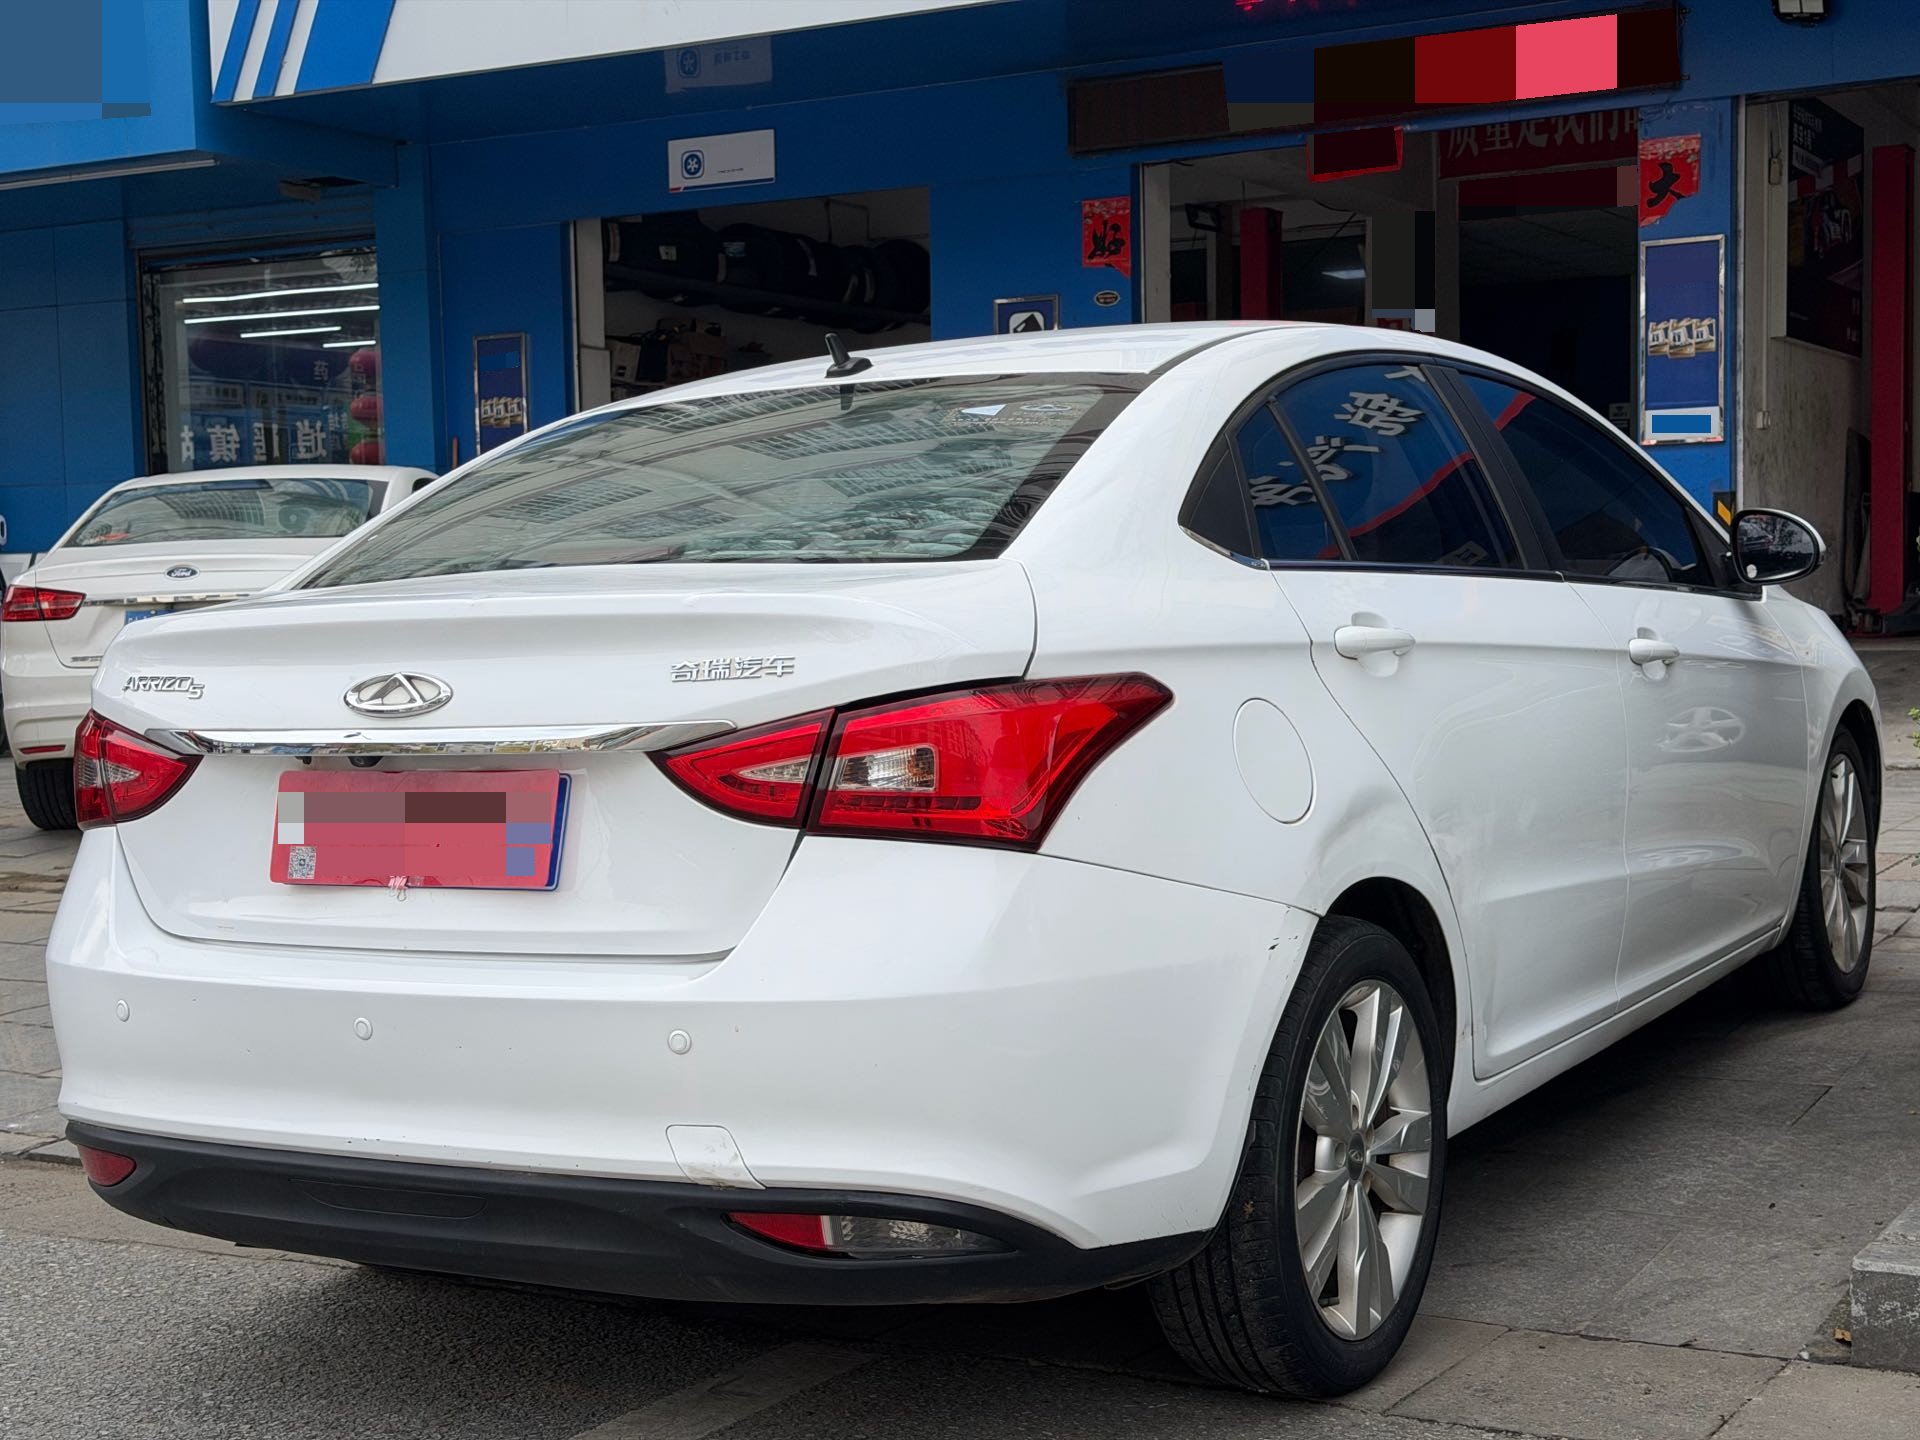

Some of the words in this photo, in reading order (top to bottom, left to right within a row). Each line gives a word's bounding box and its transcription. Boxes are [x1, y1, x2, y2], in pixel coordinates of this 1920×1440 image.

[170, 568, 193, 577] Ford
[670, 654, 796, 683] 奇瑞汽车
